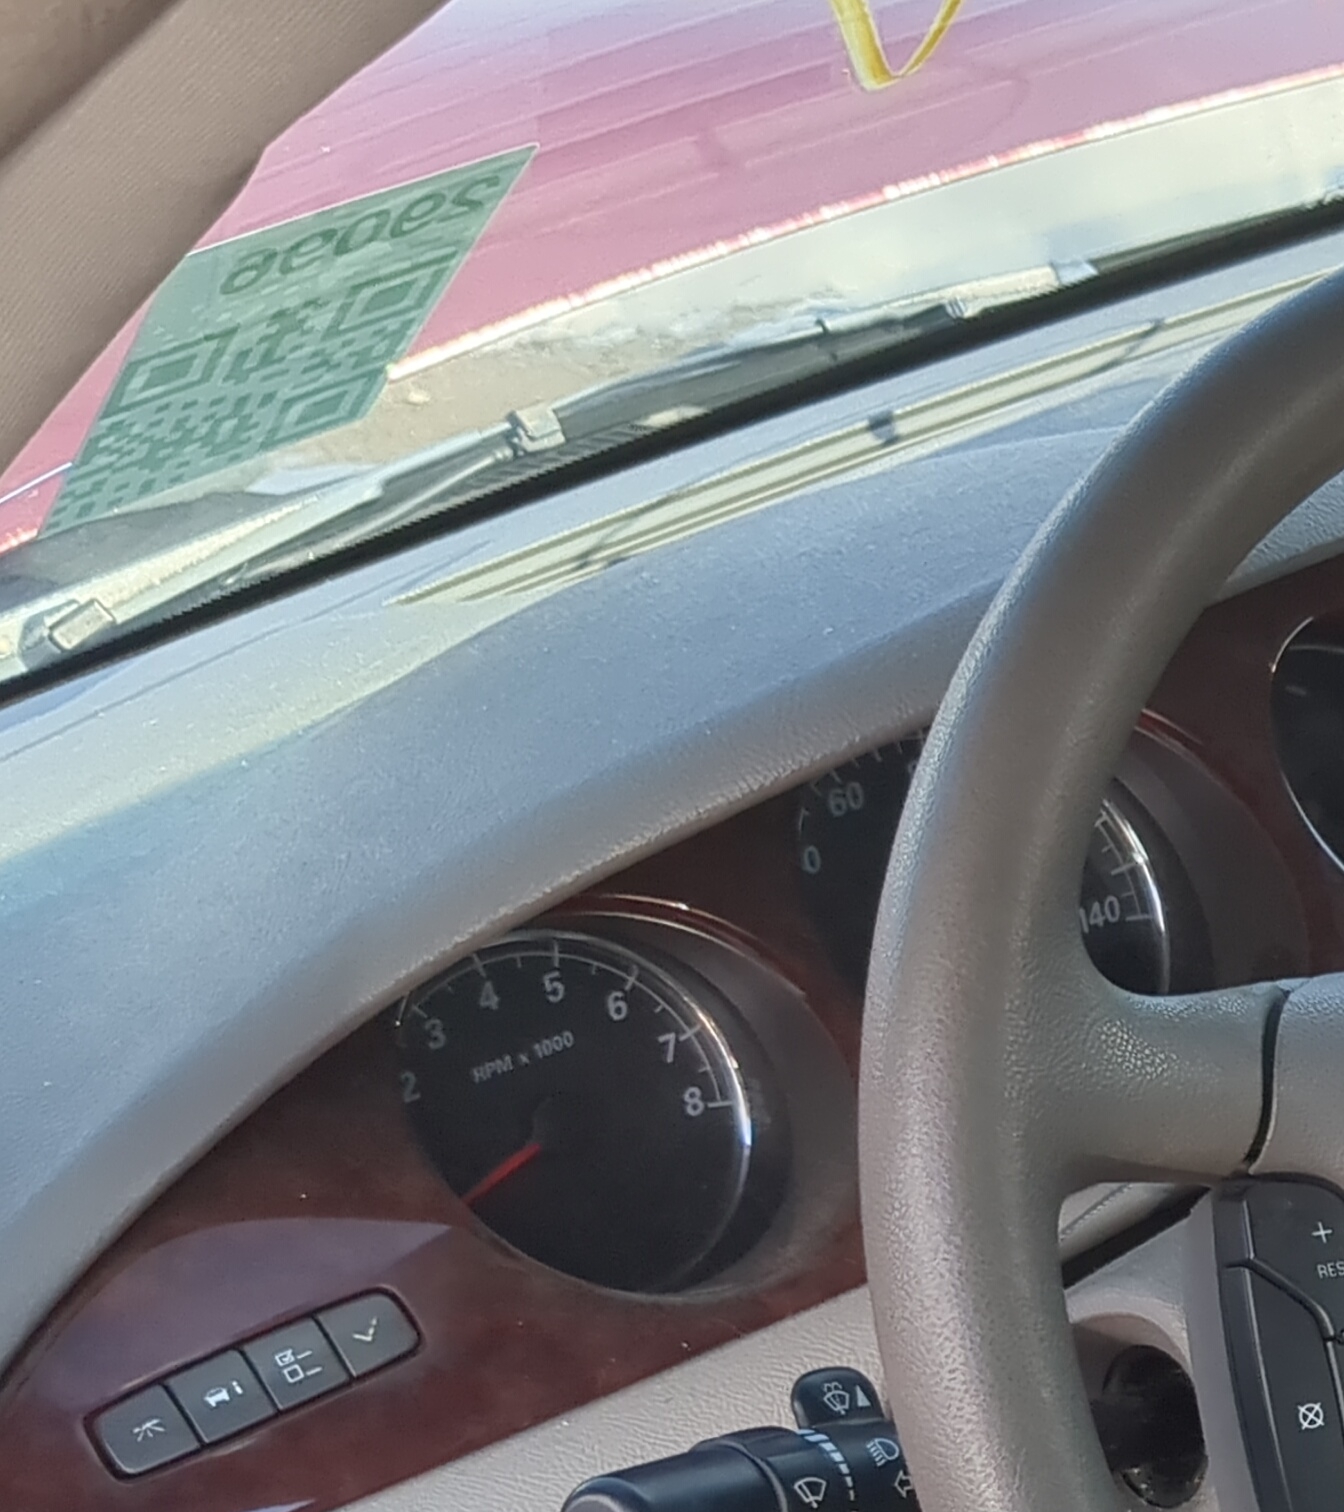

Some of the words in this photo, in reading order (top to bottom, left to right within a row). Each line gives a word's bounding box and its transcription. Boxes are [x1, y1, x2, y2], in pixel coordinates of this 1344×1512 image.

[827, 781, 864, 818] 60
[1077, 895, 1121, 934] 140
[477, 979, 500, 1011] 4
[543, 970, 565, 1003] 5
[606, 989, 630, 1021] 6
[425, 1017, 447, 1050] 3
[658, 1034, 680, 1064] 7
[471, 1054, 514, 1084] RPM
[533, 1030, 575, 1061] 1000
[400, 1070, 422, 1104] 2
[682, 1087, 705, 1117] 8
